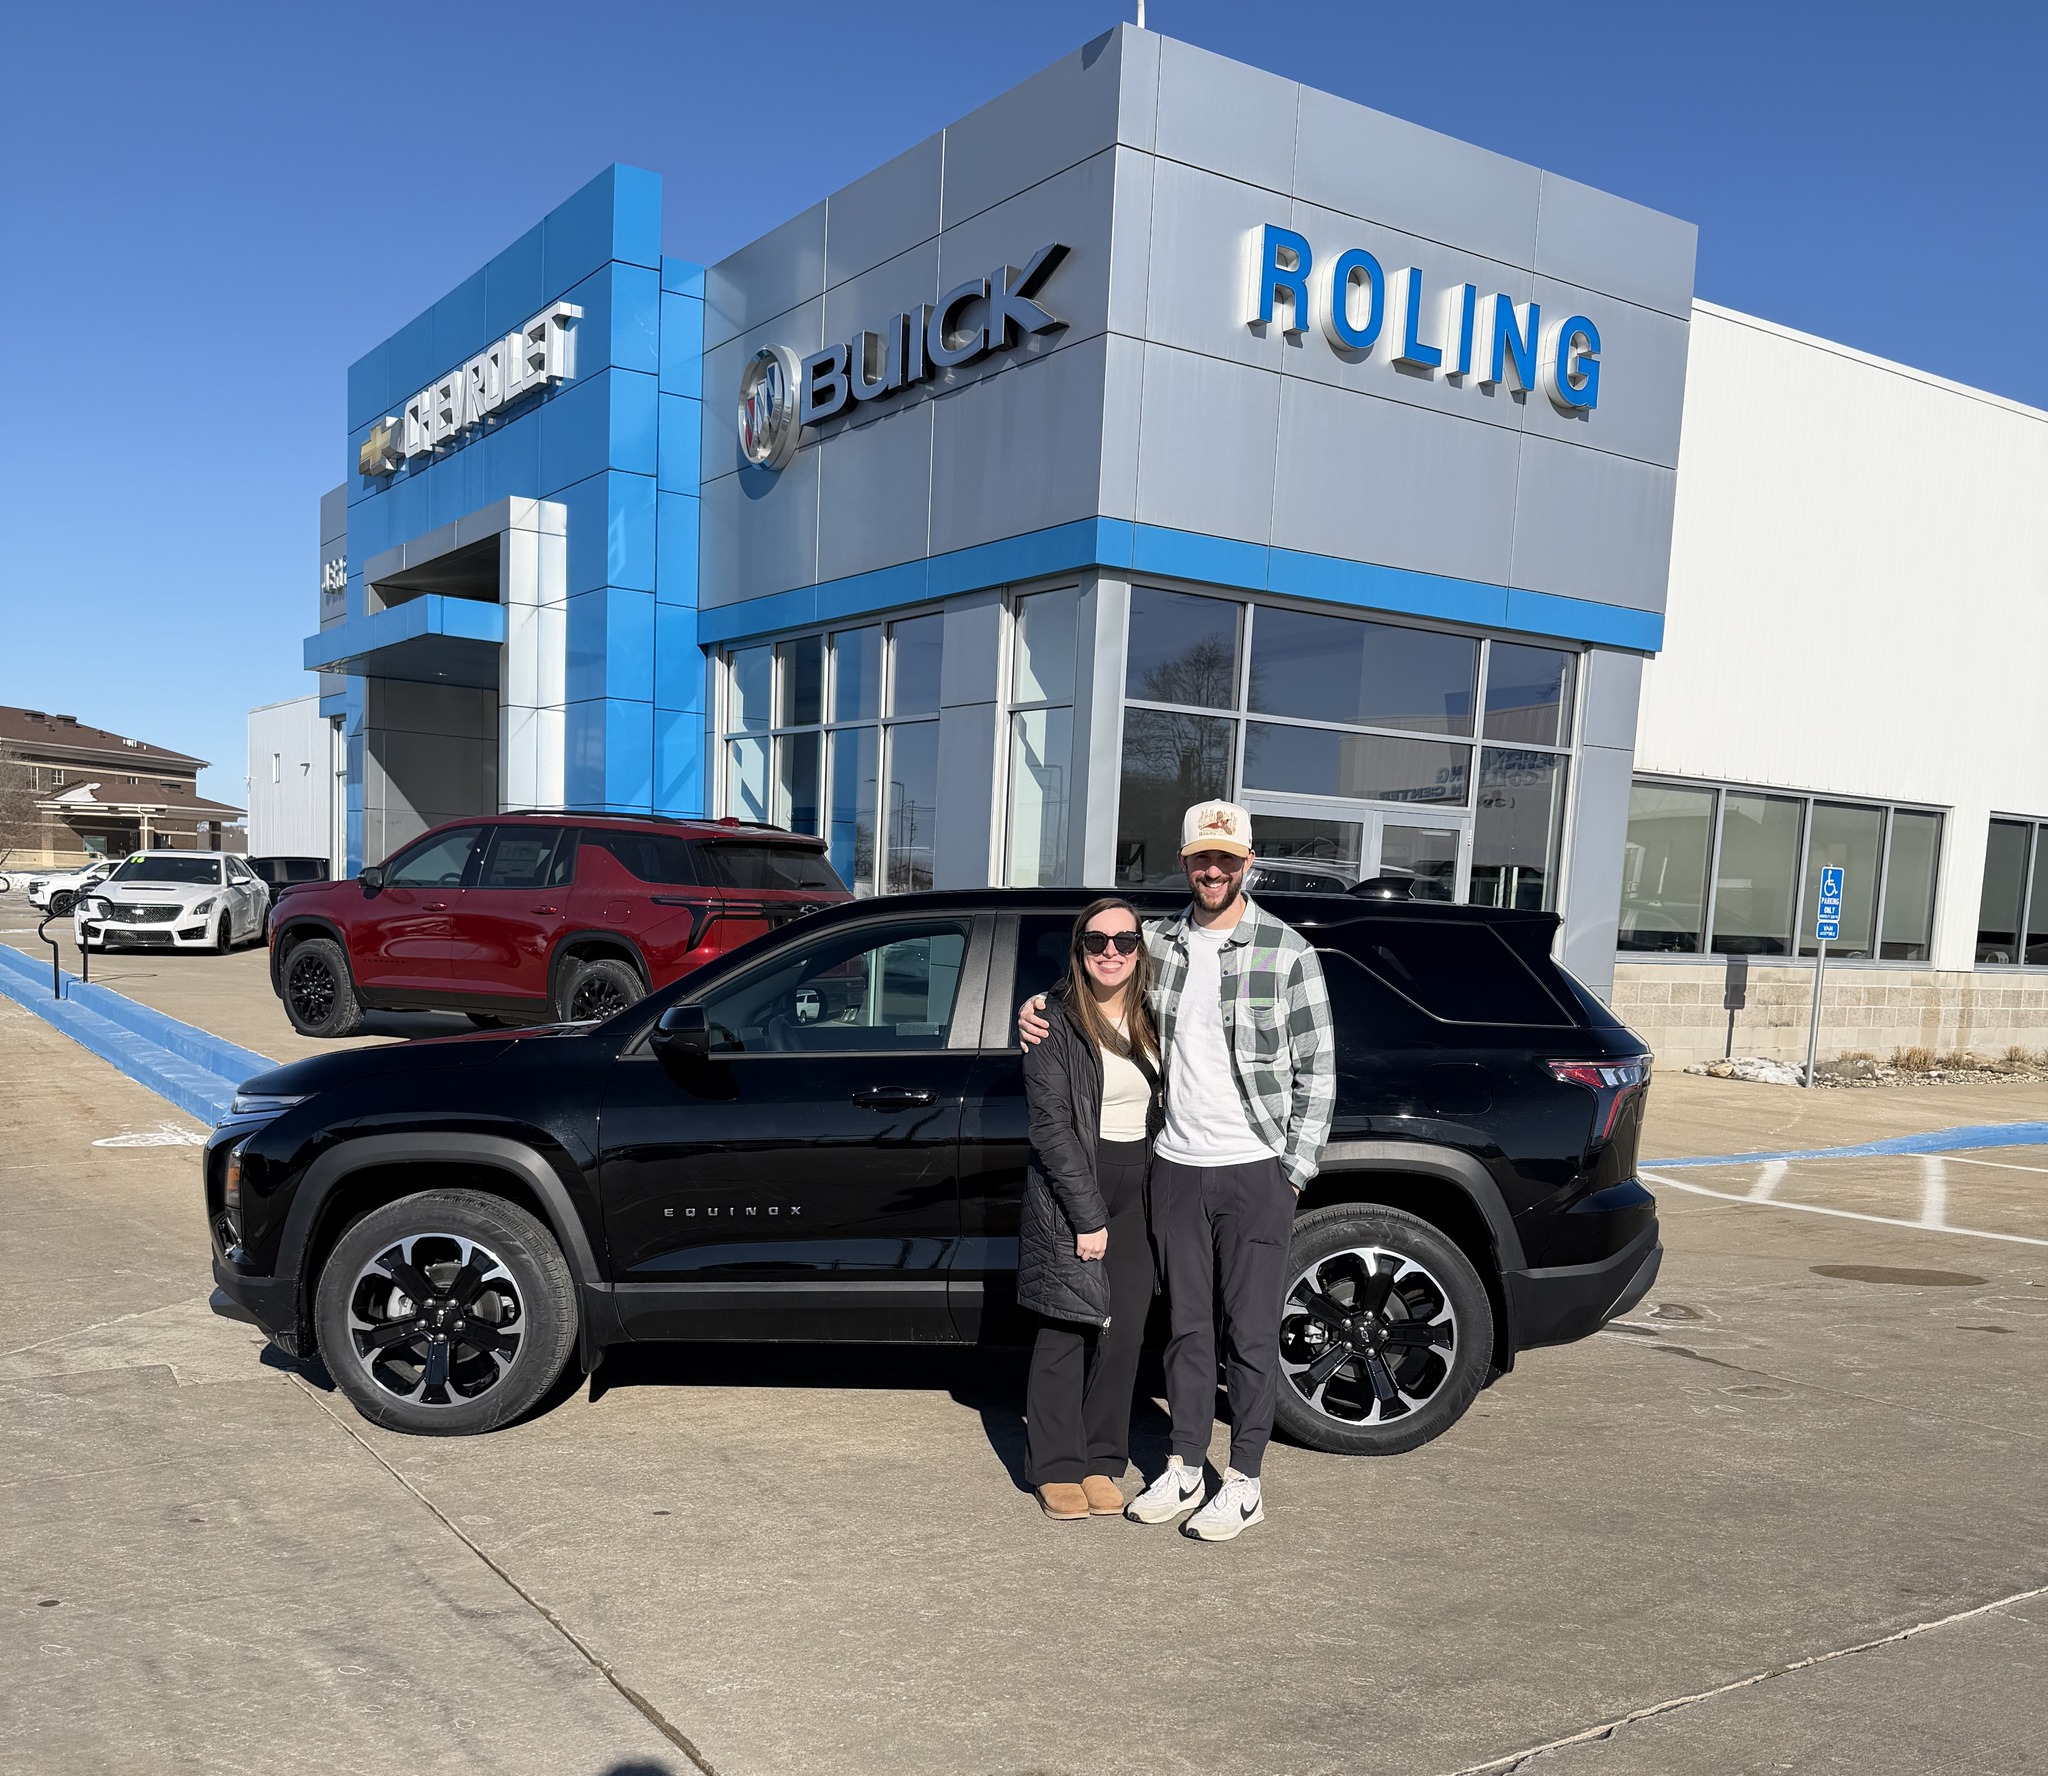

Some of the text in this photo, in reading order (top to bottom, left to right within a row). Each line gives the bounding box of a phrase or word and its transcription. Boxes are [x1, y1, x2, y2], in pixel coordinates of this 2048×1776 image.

[404, 301, 583, 459] CHEVROLET
[801, 241, 1071, 426] BUICK
[1248, 223, 1601, 410] ROLING
[664, 1206, 801, 1217] EQUINOX
